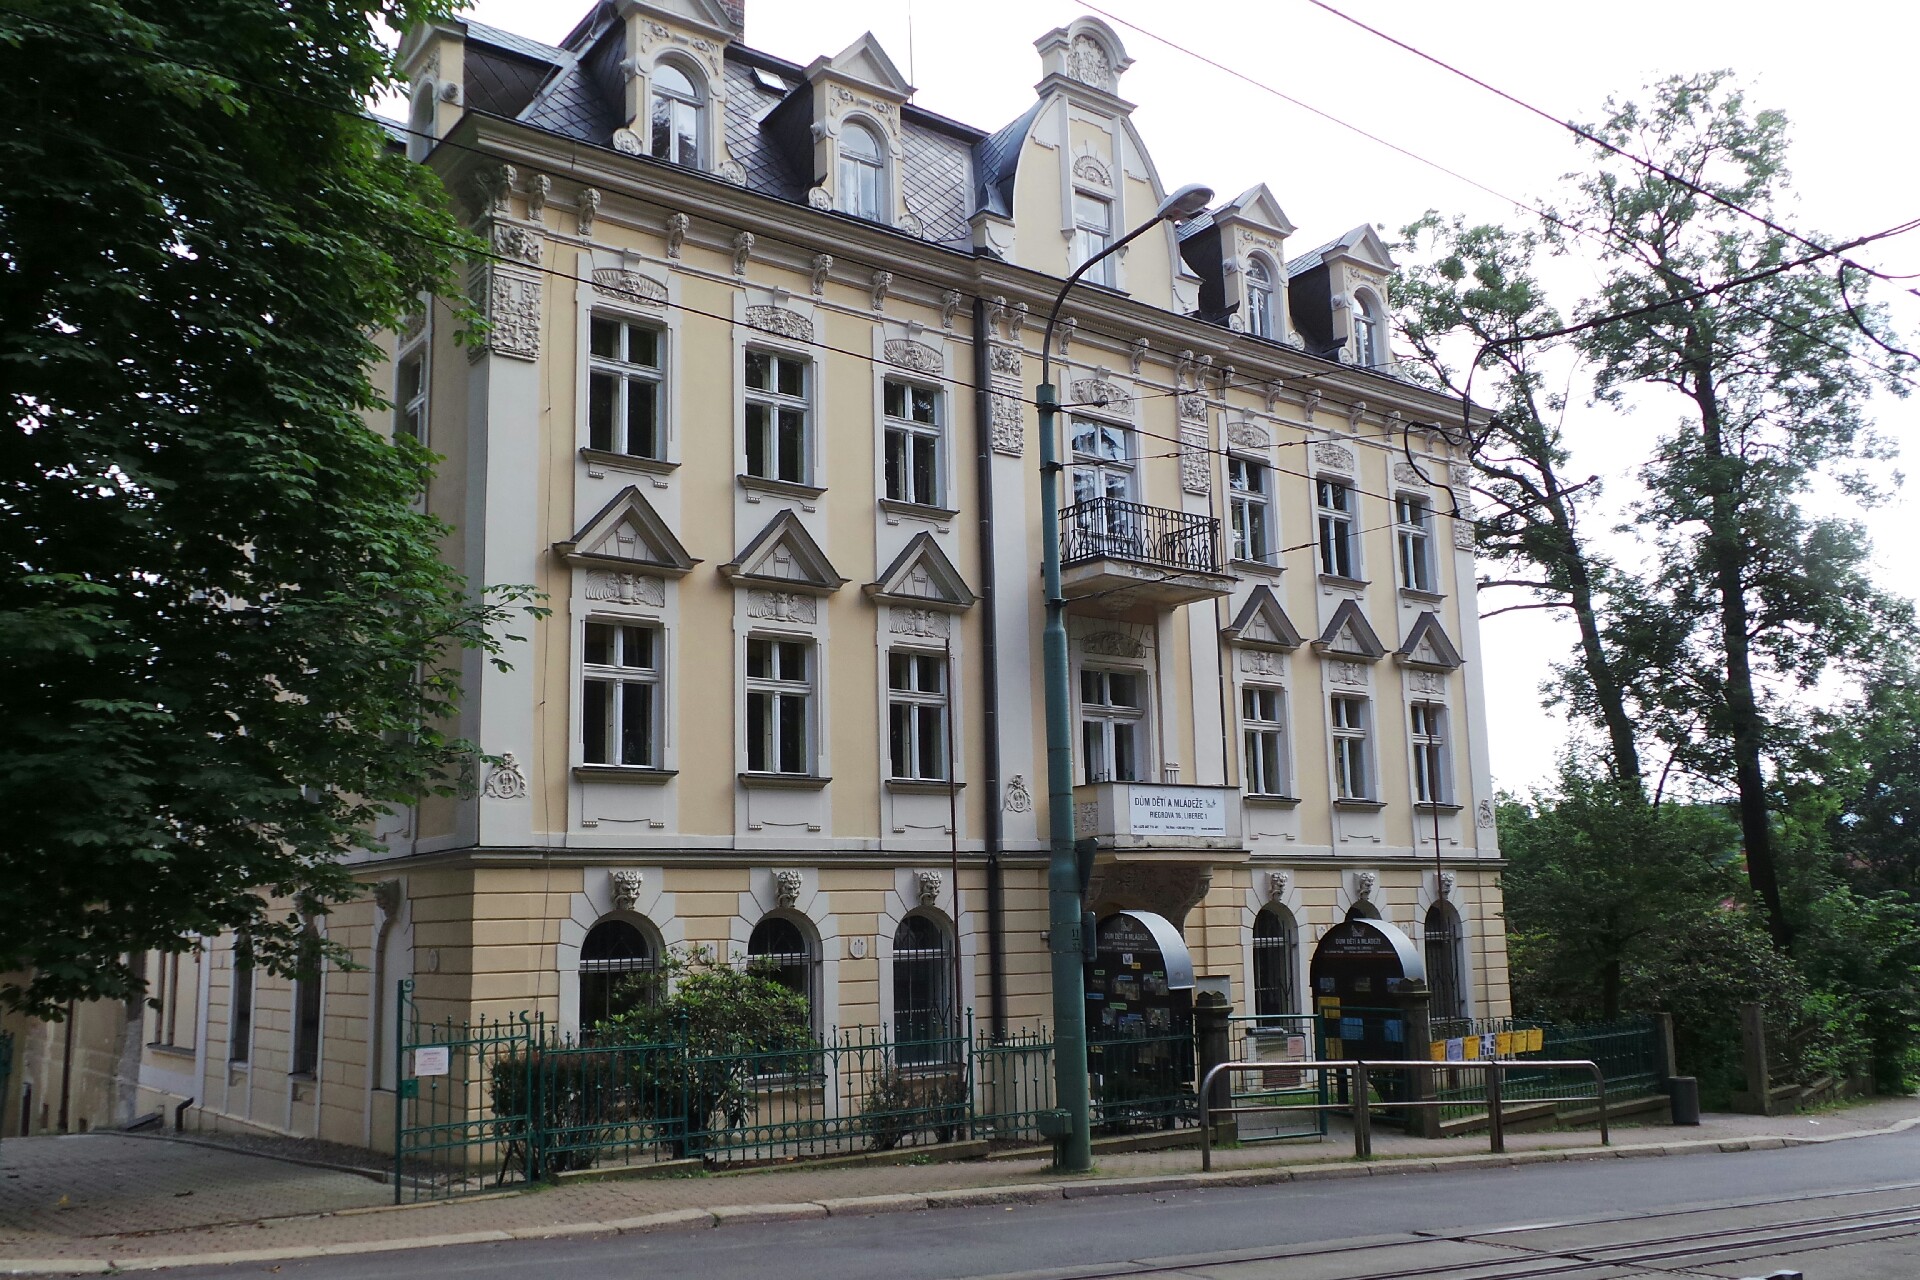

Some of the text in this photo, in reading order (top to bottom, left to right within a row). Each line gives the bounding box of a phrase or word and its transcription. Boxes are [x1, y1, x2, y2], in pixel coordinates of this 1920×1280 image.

[1134, 795, 1203, 809] DŮM DĚTÍ A MLÁDEŽE
[1149, 811, 1175, 819] RIEGROVA
[1183, 812, 1204, 820] LIBEREC
